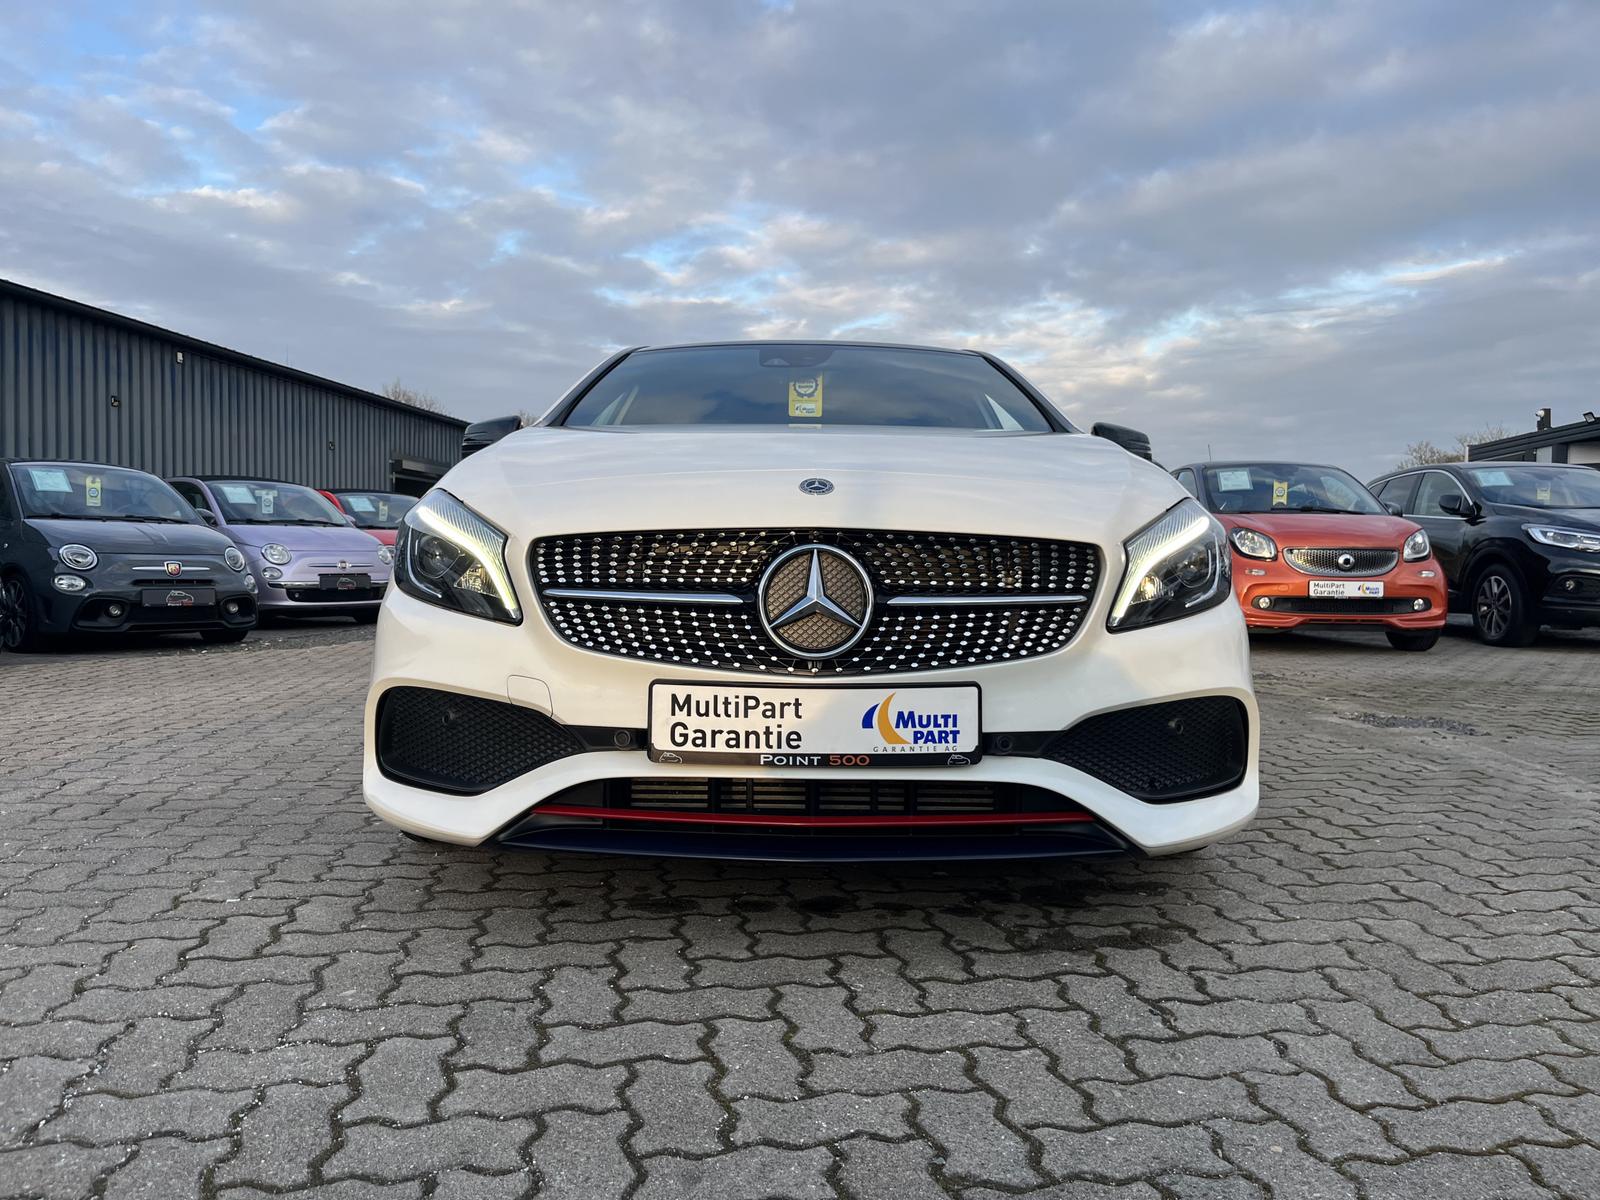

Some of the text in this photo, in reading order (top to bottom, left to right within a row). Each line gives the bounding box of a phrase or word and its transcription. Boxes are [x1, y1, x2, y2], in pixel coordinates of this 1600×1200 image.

[671, 693, 803, 719] MultiPart
[895, 711, 958, 729] MULTI
[670, 722, 802, 749] Garantie
[913, 730, 960, 744] PART
[760, 754, 870, 766] POINT 500
